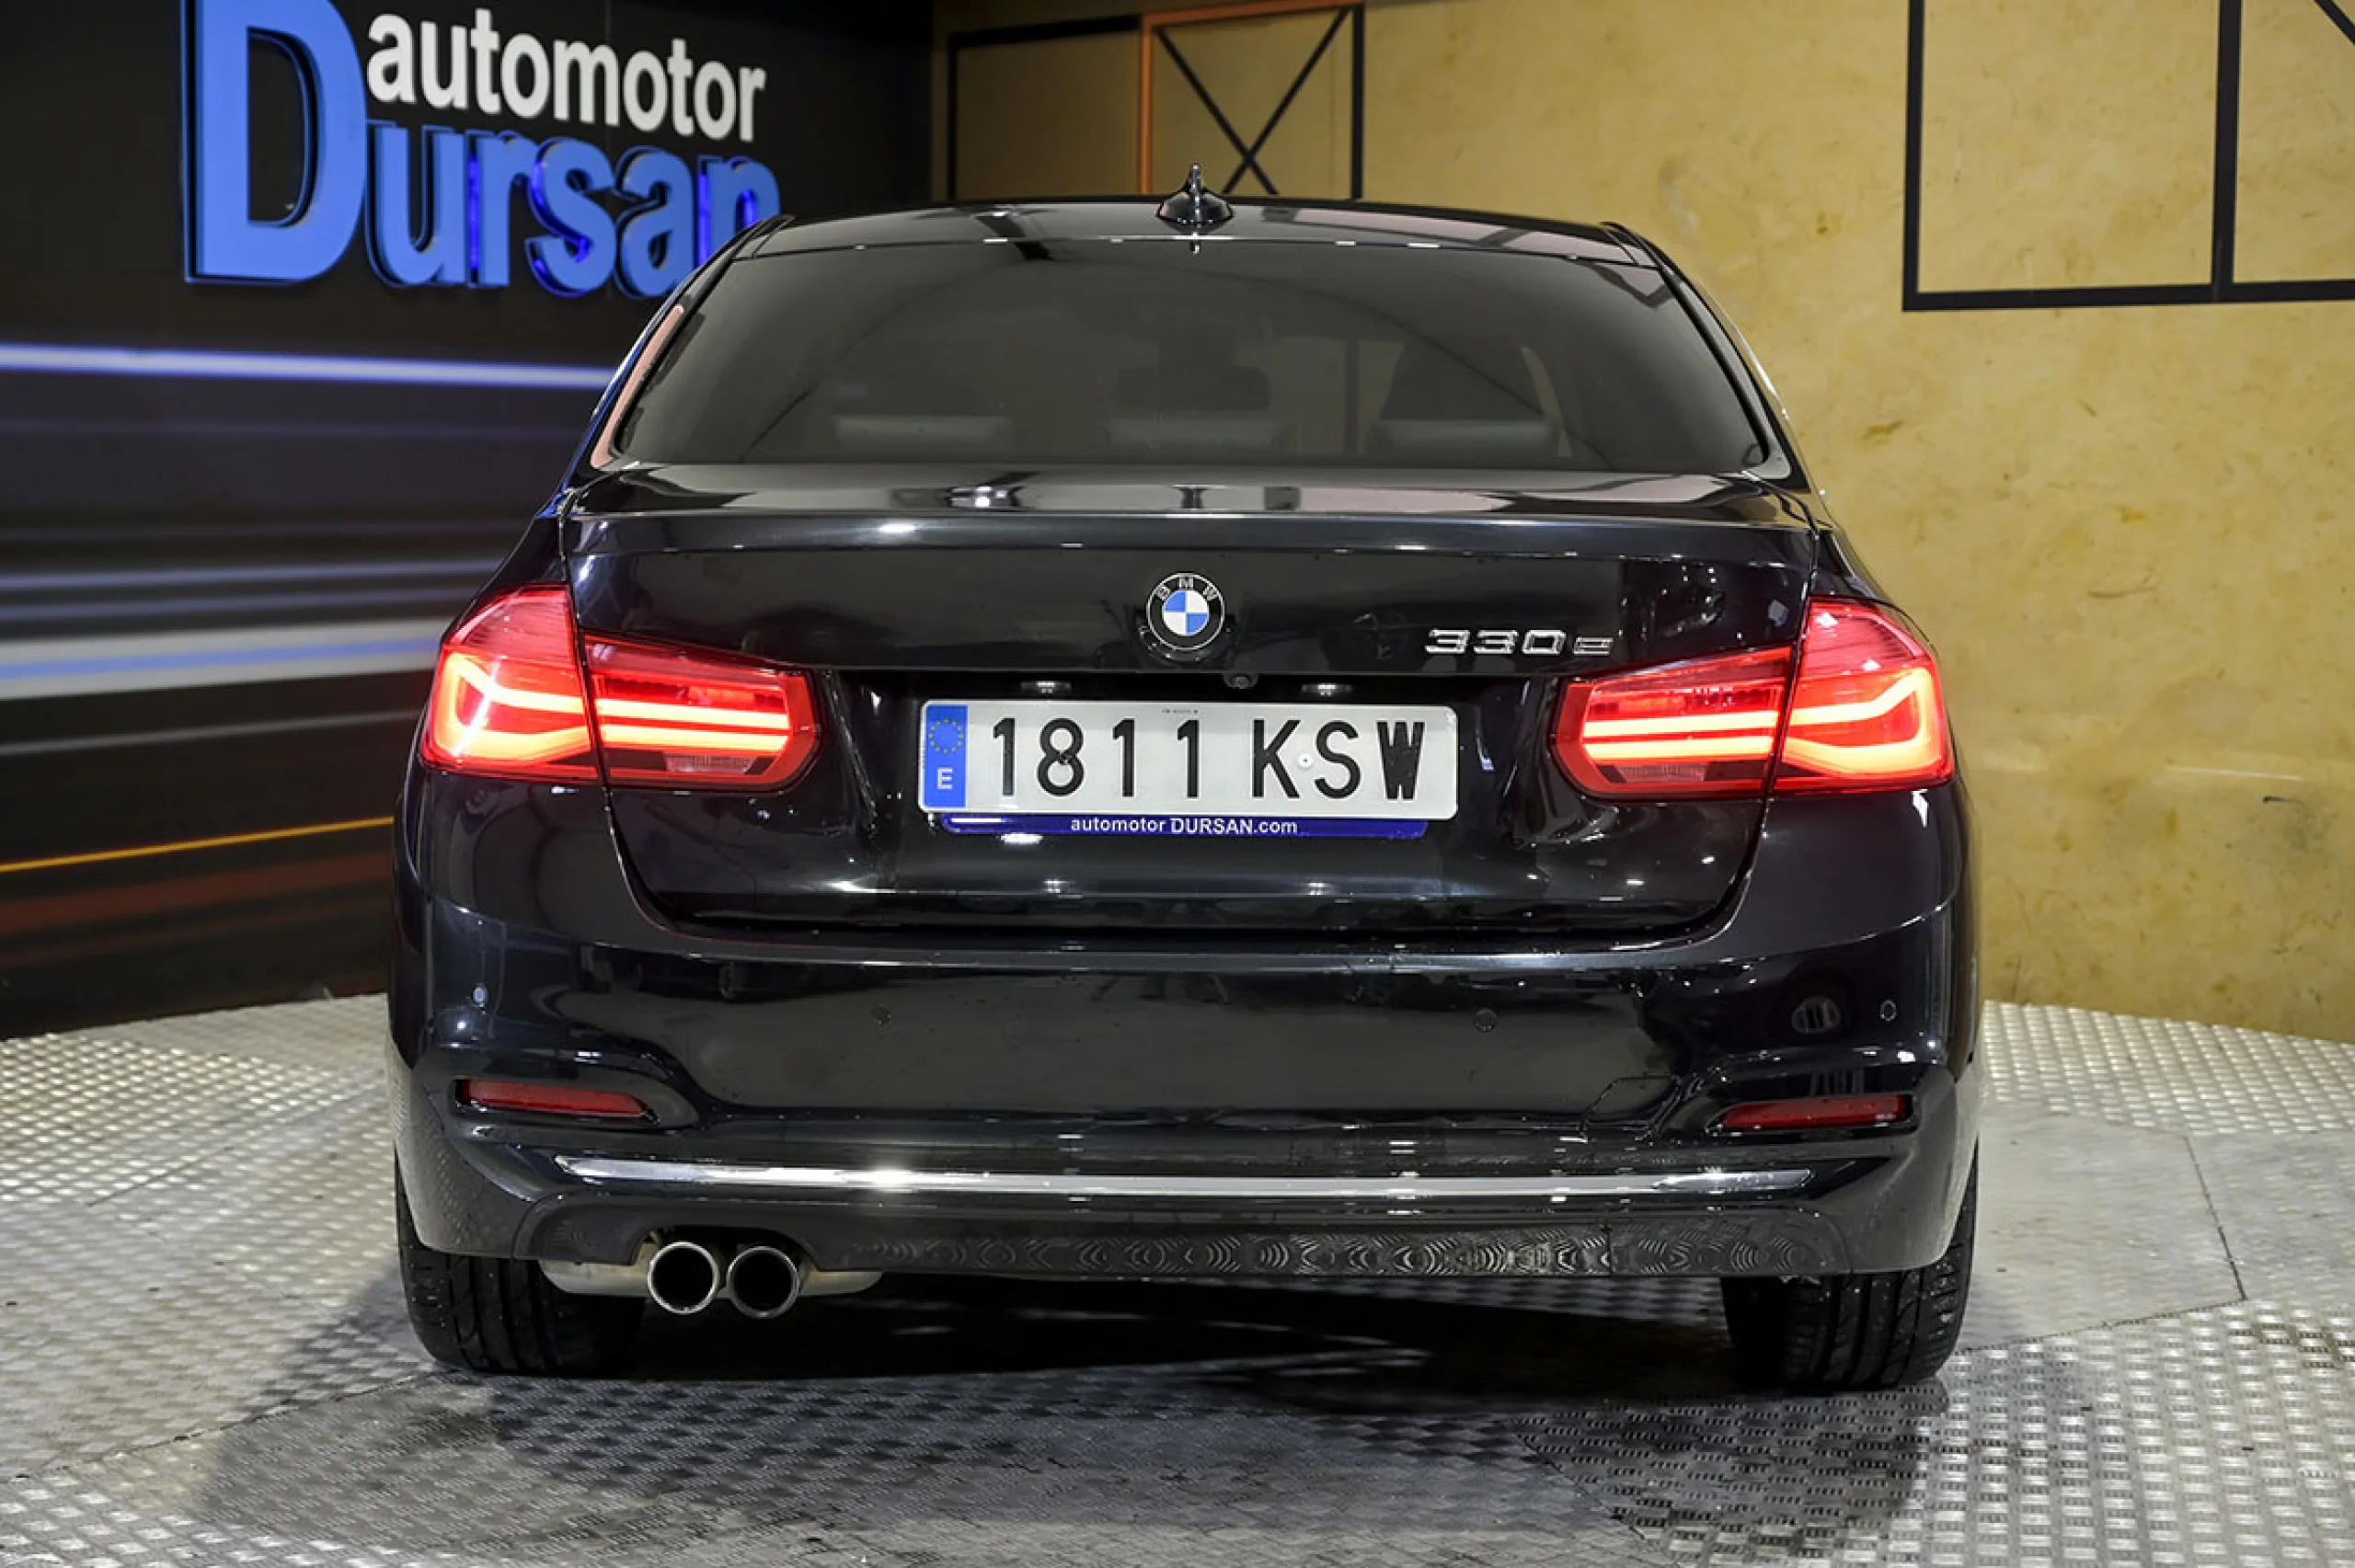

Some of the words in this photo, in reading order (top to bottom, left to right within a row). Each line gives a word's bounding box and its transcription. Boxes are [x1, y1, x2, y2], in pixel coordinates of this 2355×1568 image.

[367, 7, 766, 143] automotor
[181, 0, 780, 299] Dursan
[1156, 577, 1217, 601] BMW
[936, 767, 953, 789] E
[993, 717, 1200, 798] 1811
[1252, 719, 1425, 799] KSW
[1070, 818, 1166, 832] automotor
[1170, 818, 1298, 834] DURSAN.com
